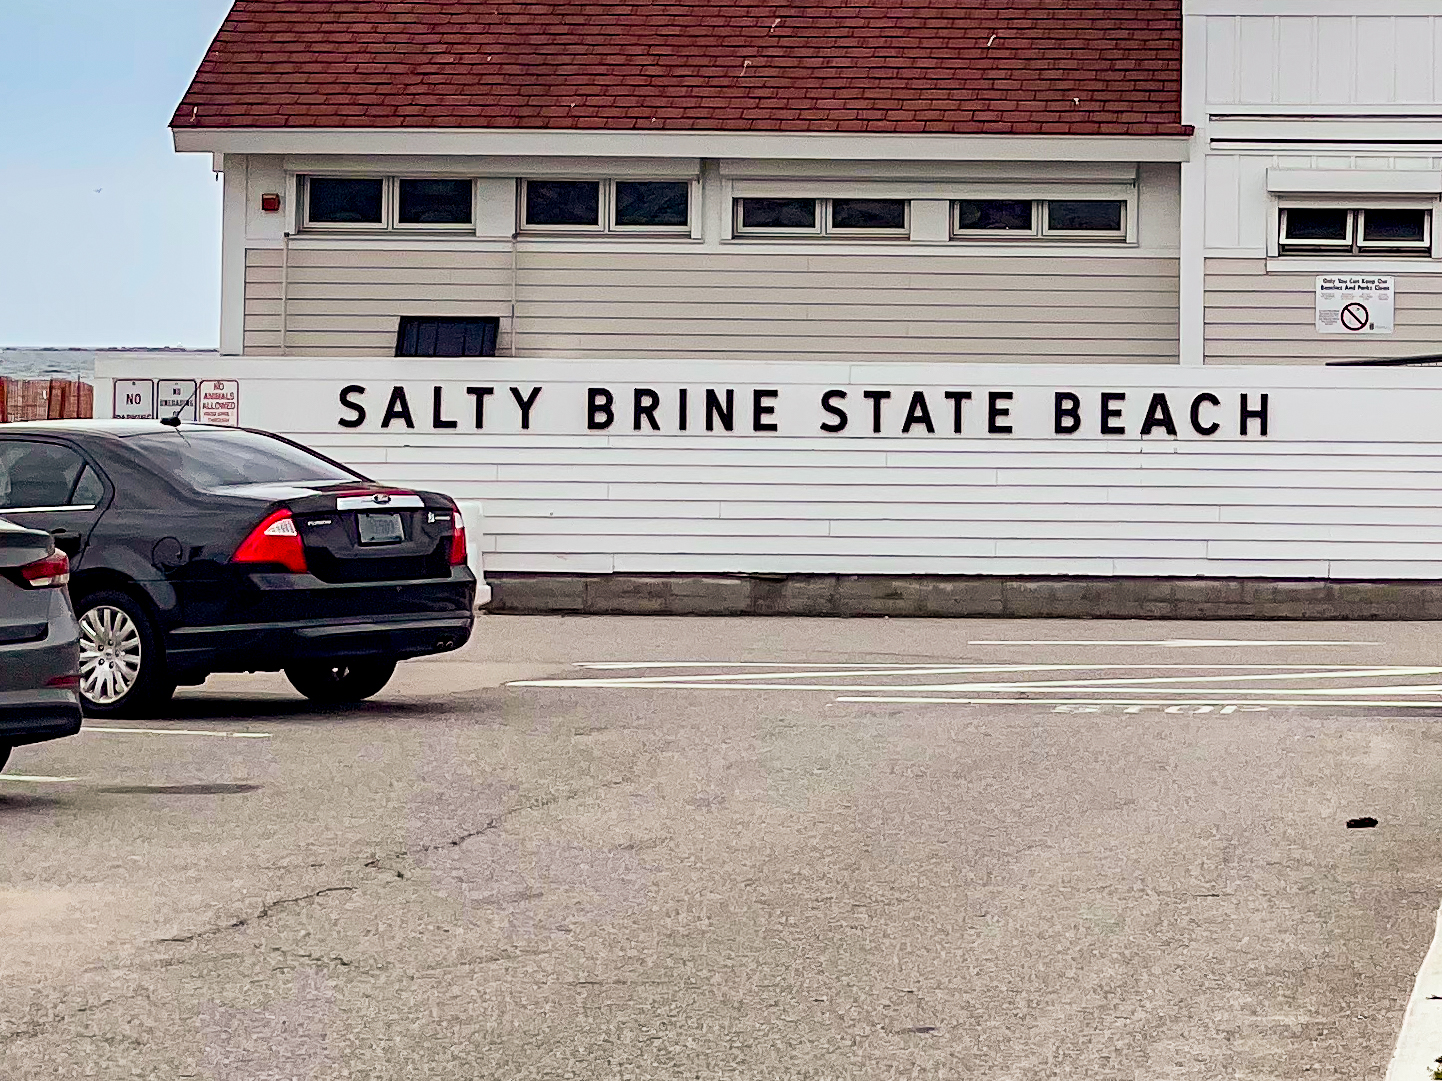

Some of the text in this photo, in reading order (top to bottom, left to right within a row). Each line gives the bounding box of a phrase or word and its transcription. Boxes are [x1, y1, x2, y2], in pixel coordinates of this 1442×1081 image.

[213, 382, 225, 391] NO
[126, 393, 142, 404] NO
[203, 392, 234, 400] ANIMALS
[202, 401, 236, 410] ALLOWED
[337, 384, 1269, 437] SALTY BRINE STATE BEACH
